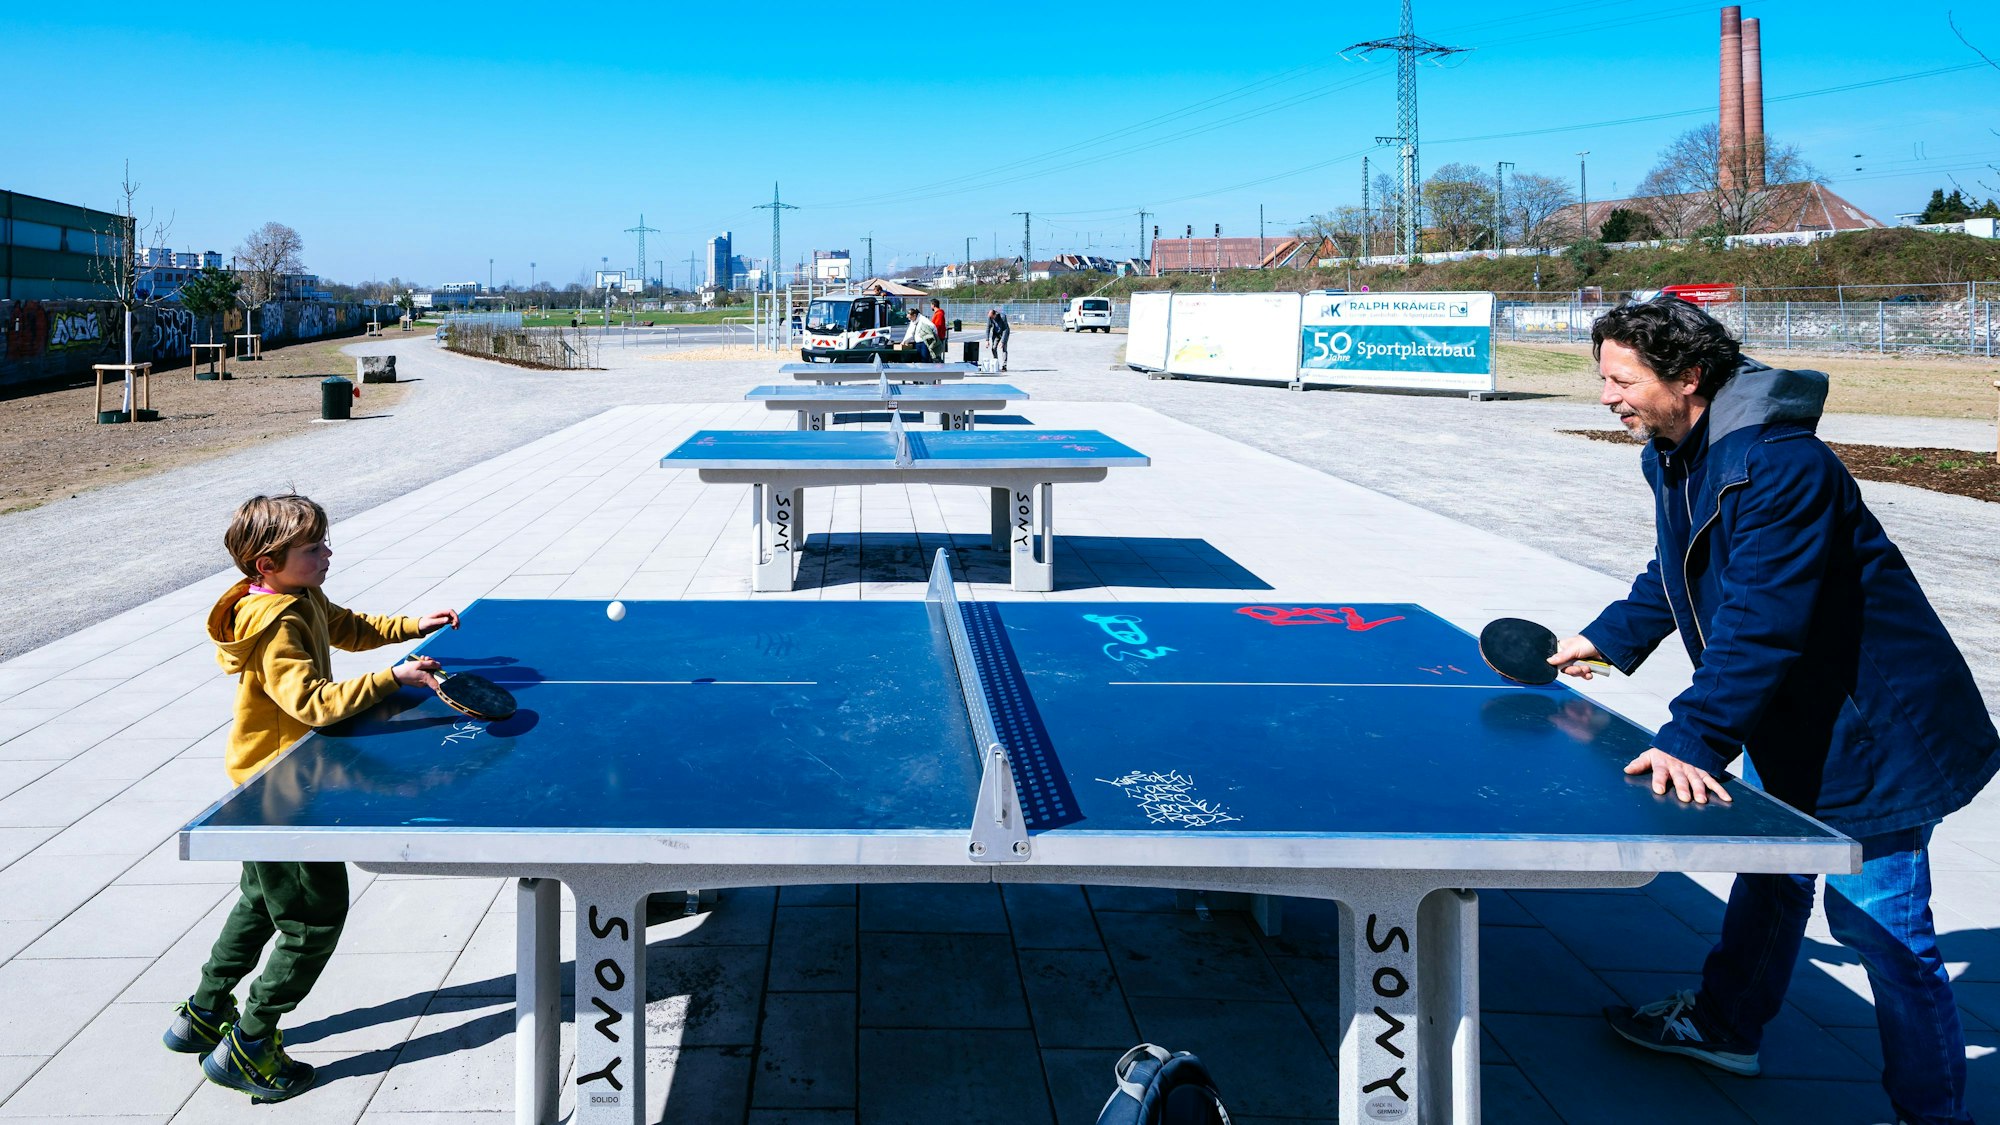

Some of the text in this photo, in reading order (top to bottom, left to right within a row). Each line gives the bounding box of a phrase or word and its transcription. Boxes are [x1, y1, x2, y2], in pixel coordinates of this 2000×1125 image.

[1320, 303, 1342, 318] RK
[1350, 300, 1446, 311] RALPH KRÄMER
[1313, 331, 1352, 361] 50
[1328, 353, 1351, 362] Jahre
[1357, 341, 1476, 360] Sportplatzbau
[774, 494, 791, 551] SONY
[1013, 491, 1030, 546] SONY
[576, 905, 629, 1091] SONY
[1362, 913, 1410, 1101] SONY
